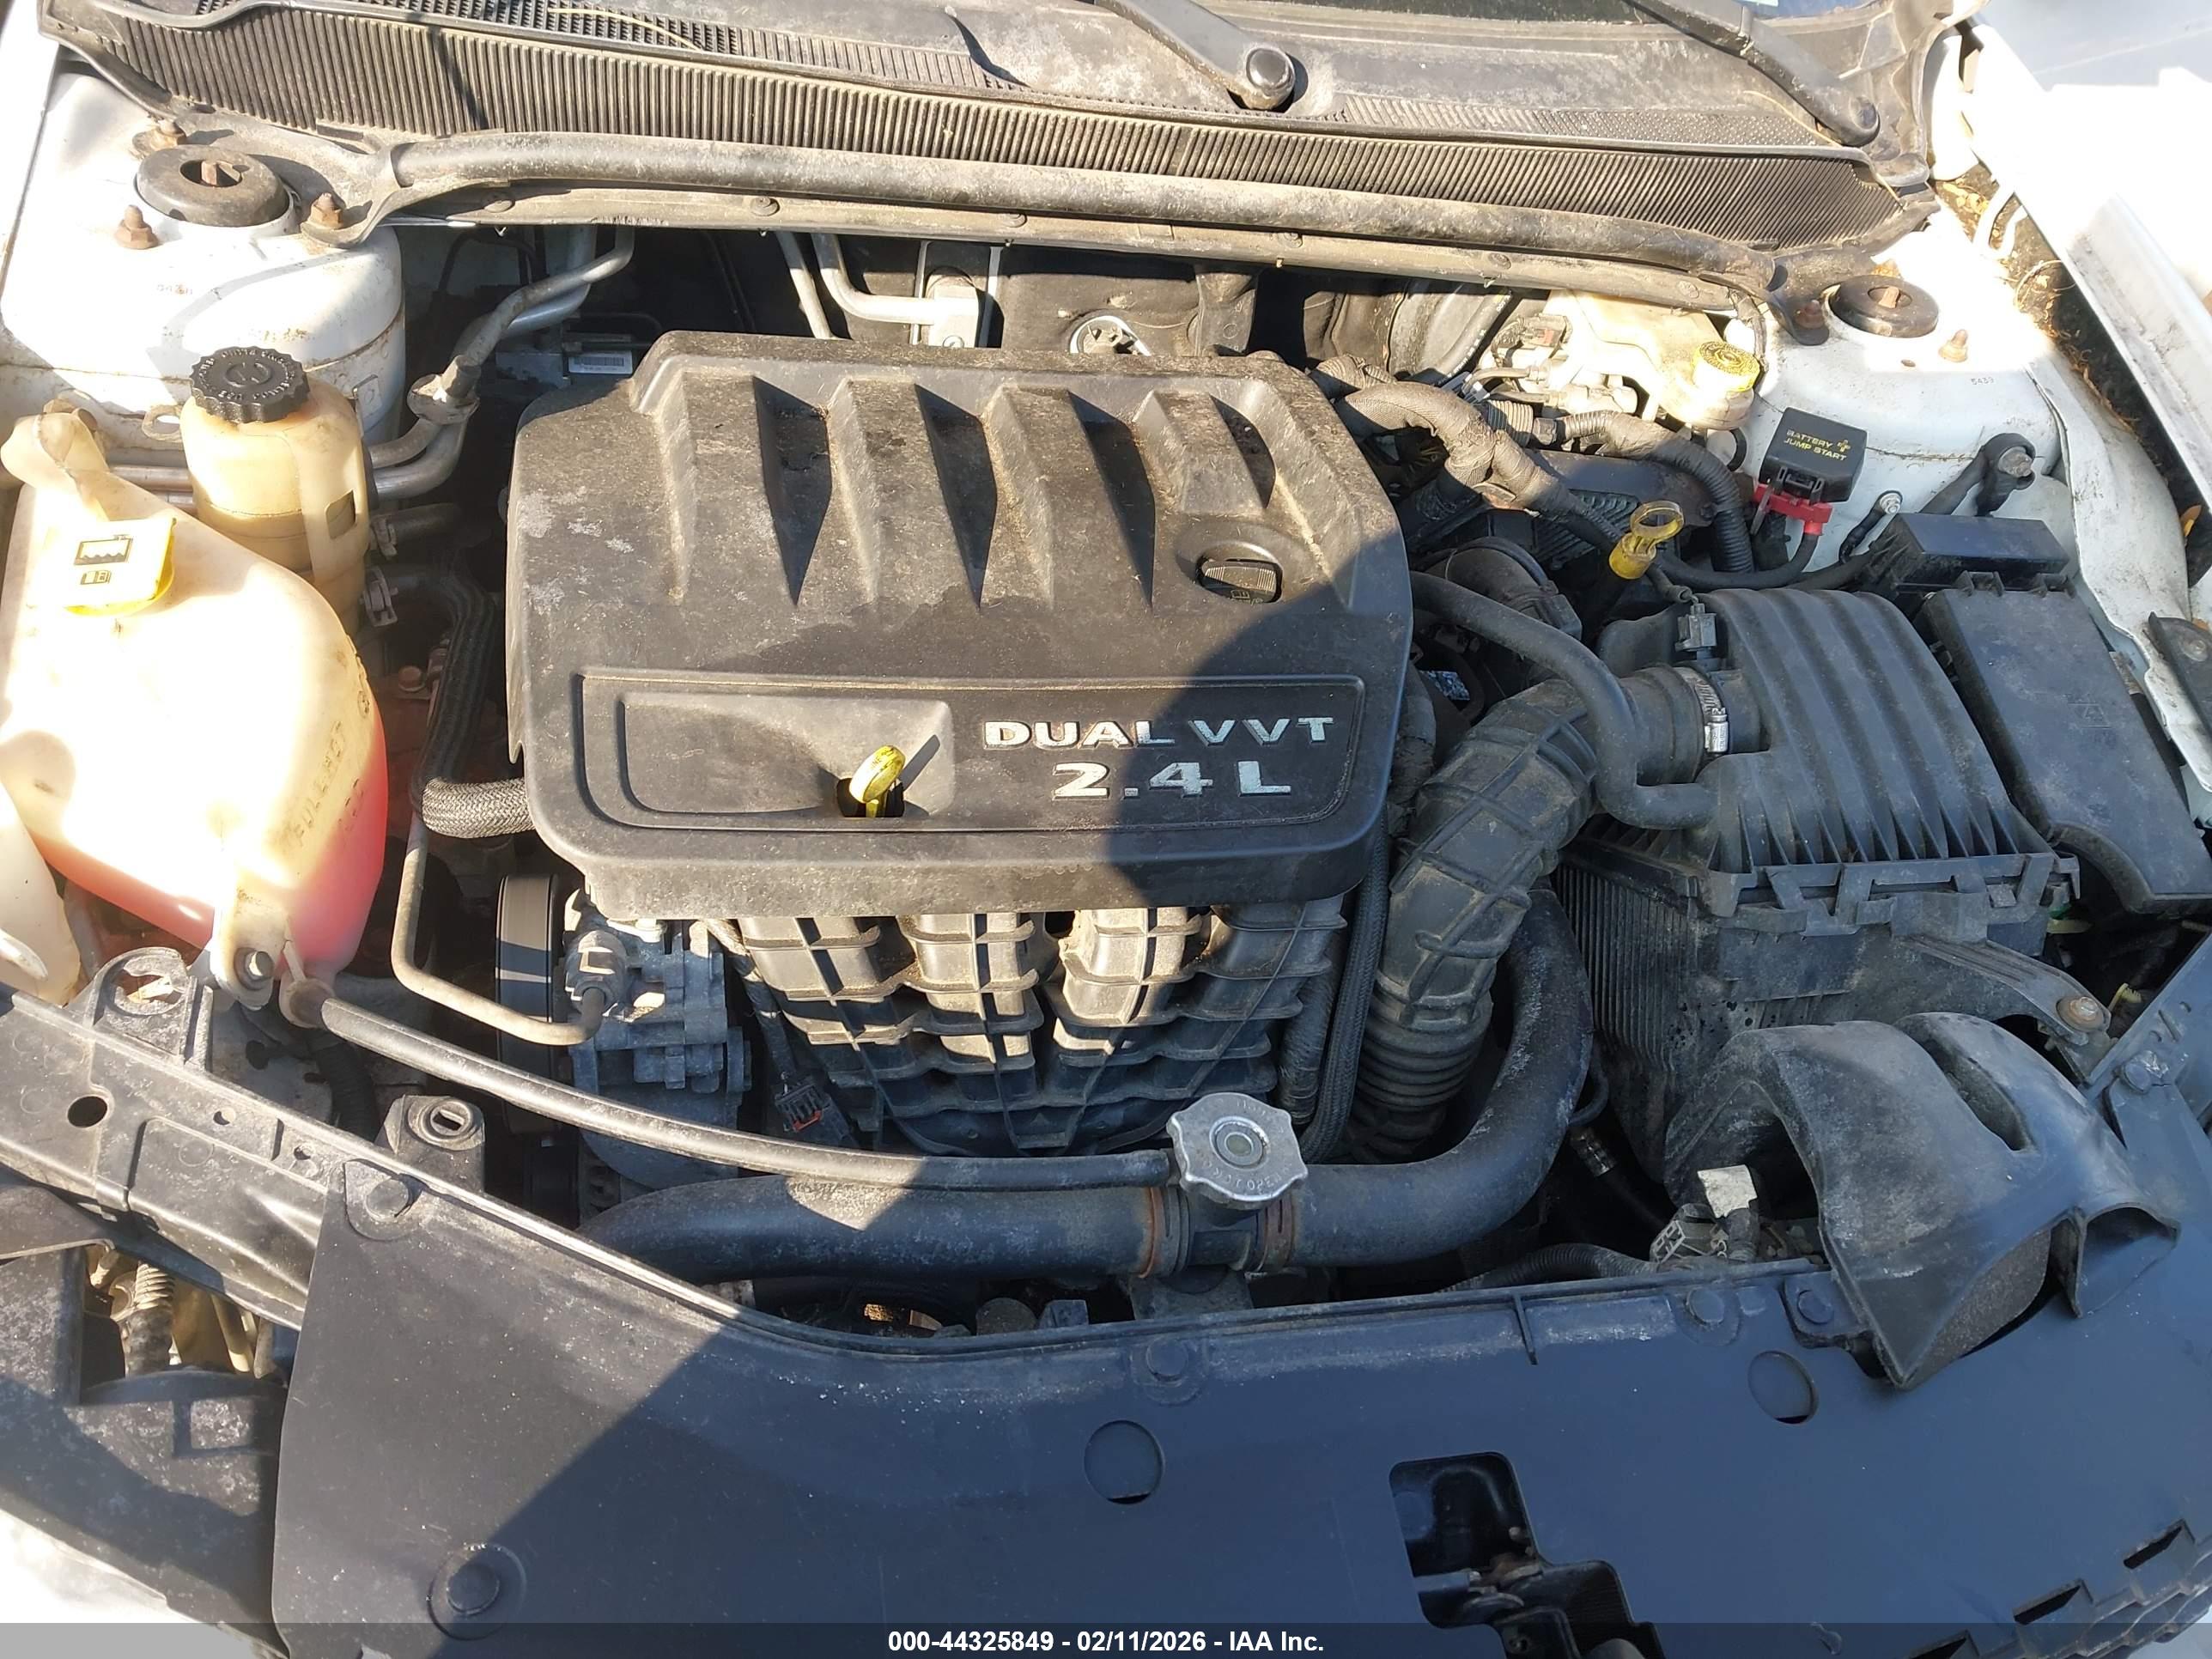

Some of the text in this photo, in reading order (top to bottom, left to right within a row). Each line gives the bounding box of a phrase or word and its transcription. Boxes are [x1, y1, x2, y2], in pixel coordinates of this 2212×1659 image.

[1786, 429, 1833, 448] BATTERY
[1784, 439, 1848, 461] JUMP START
[984, 717, 1334, 749] DUAL VVT
